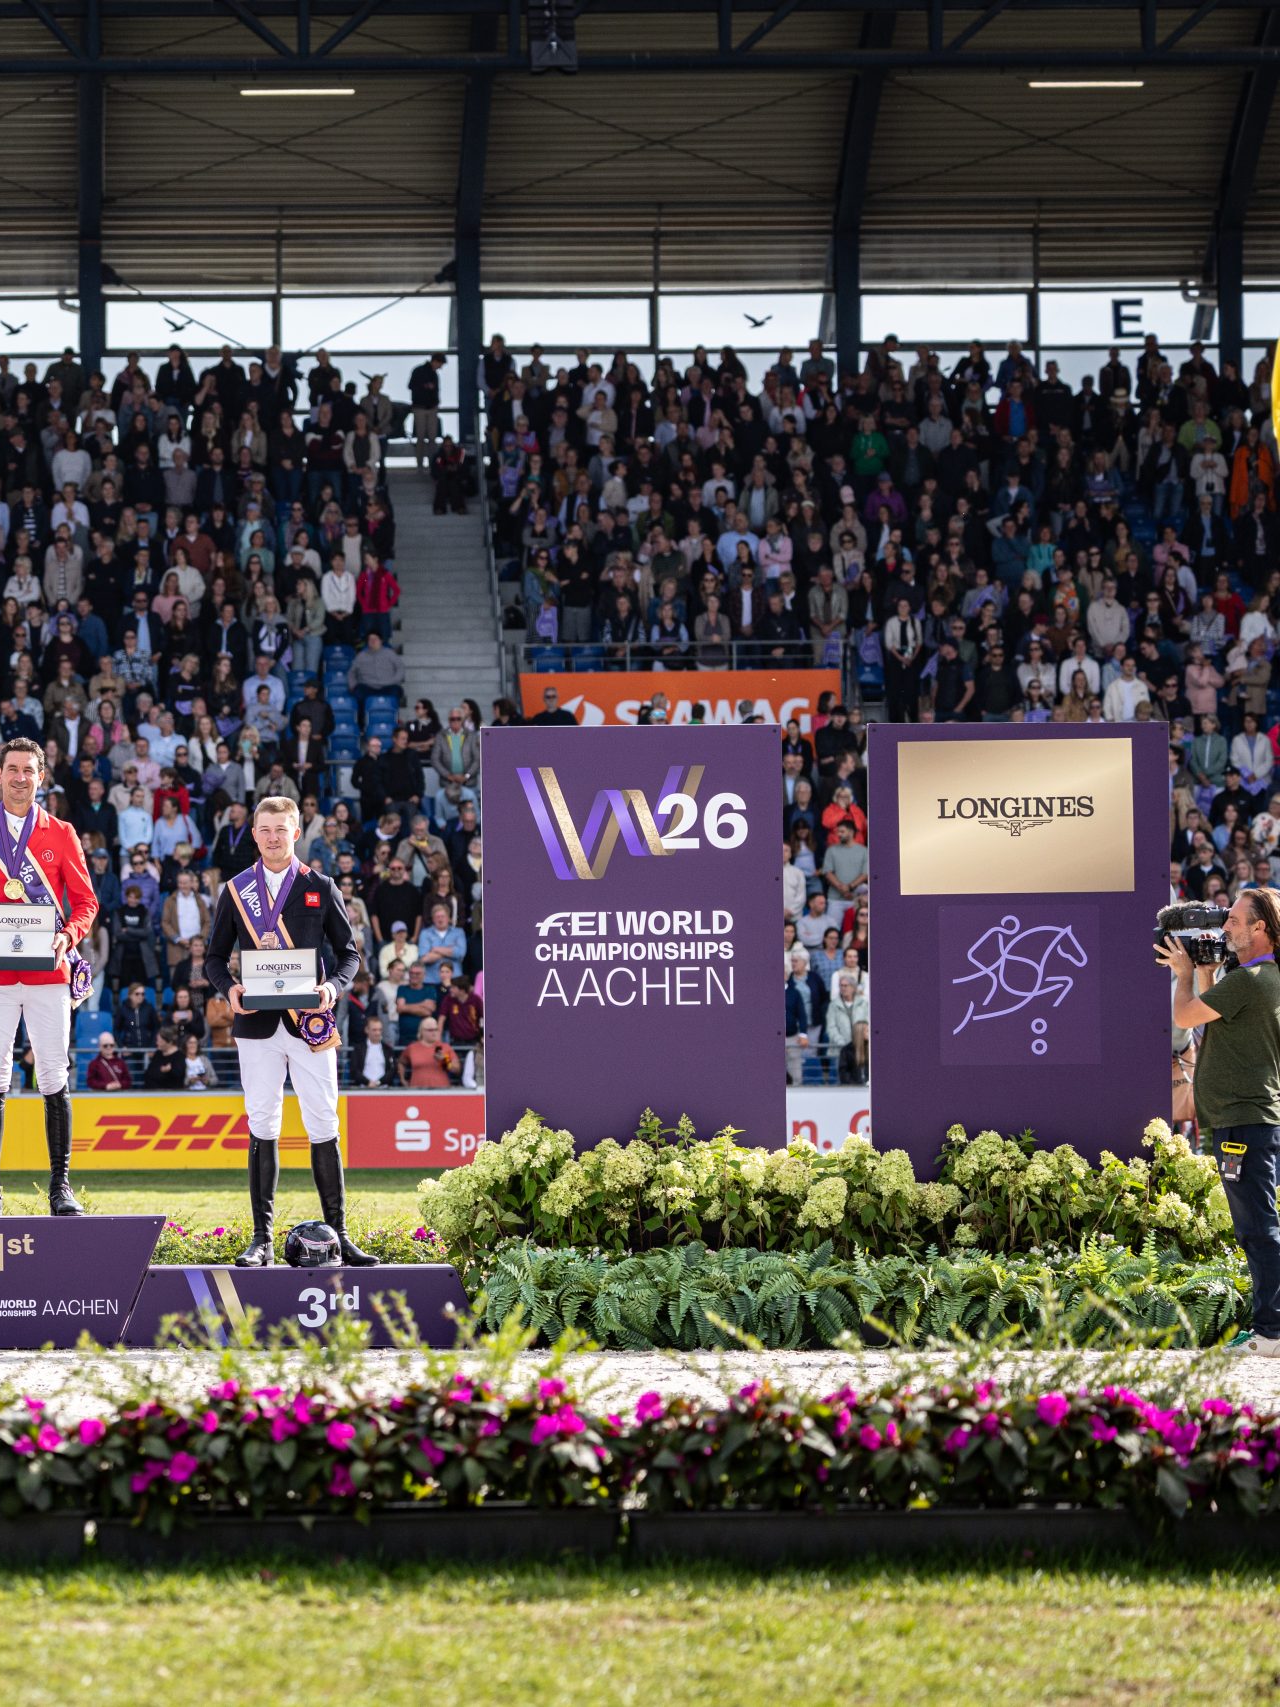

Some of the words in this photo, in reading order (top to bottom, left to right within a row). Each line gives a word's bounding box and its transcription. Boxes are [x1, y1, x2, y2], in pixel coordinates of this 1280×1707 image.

[1112, 299, 1144, 339] E
[615, 697, 812, 735] SAWAG
[937, 795, 1095, 819] LONGINES
[616, 910, 734, 936] WORLD
[535, 941, 734, 961] CHAMPIONSHIPS
[256, 963, 302, 971] LONGINES
[536, 966, 735, 1007] AACHEN
[42, 1299, 119, 1316] AACHEN
[297, 1286, 360, 1328] 3rd
